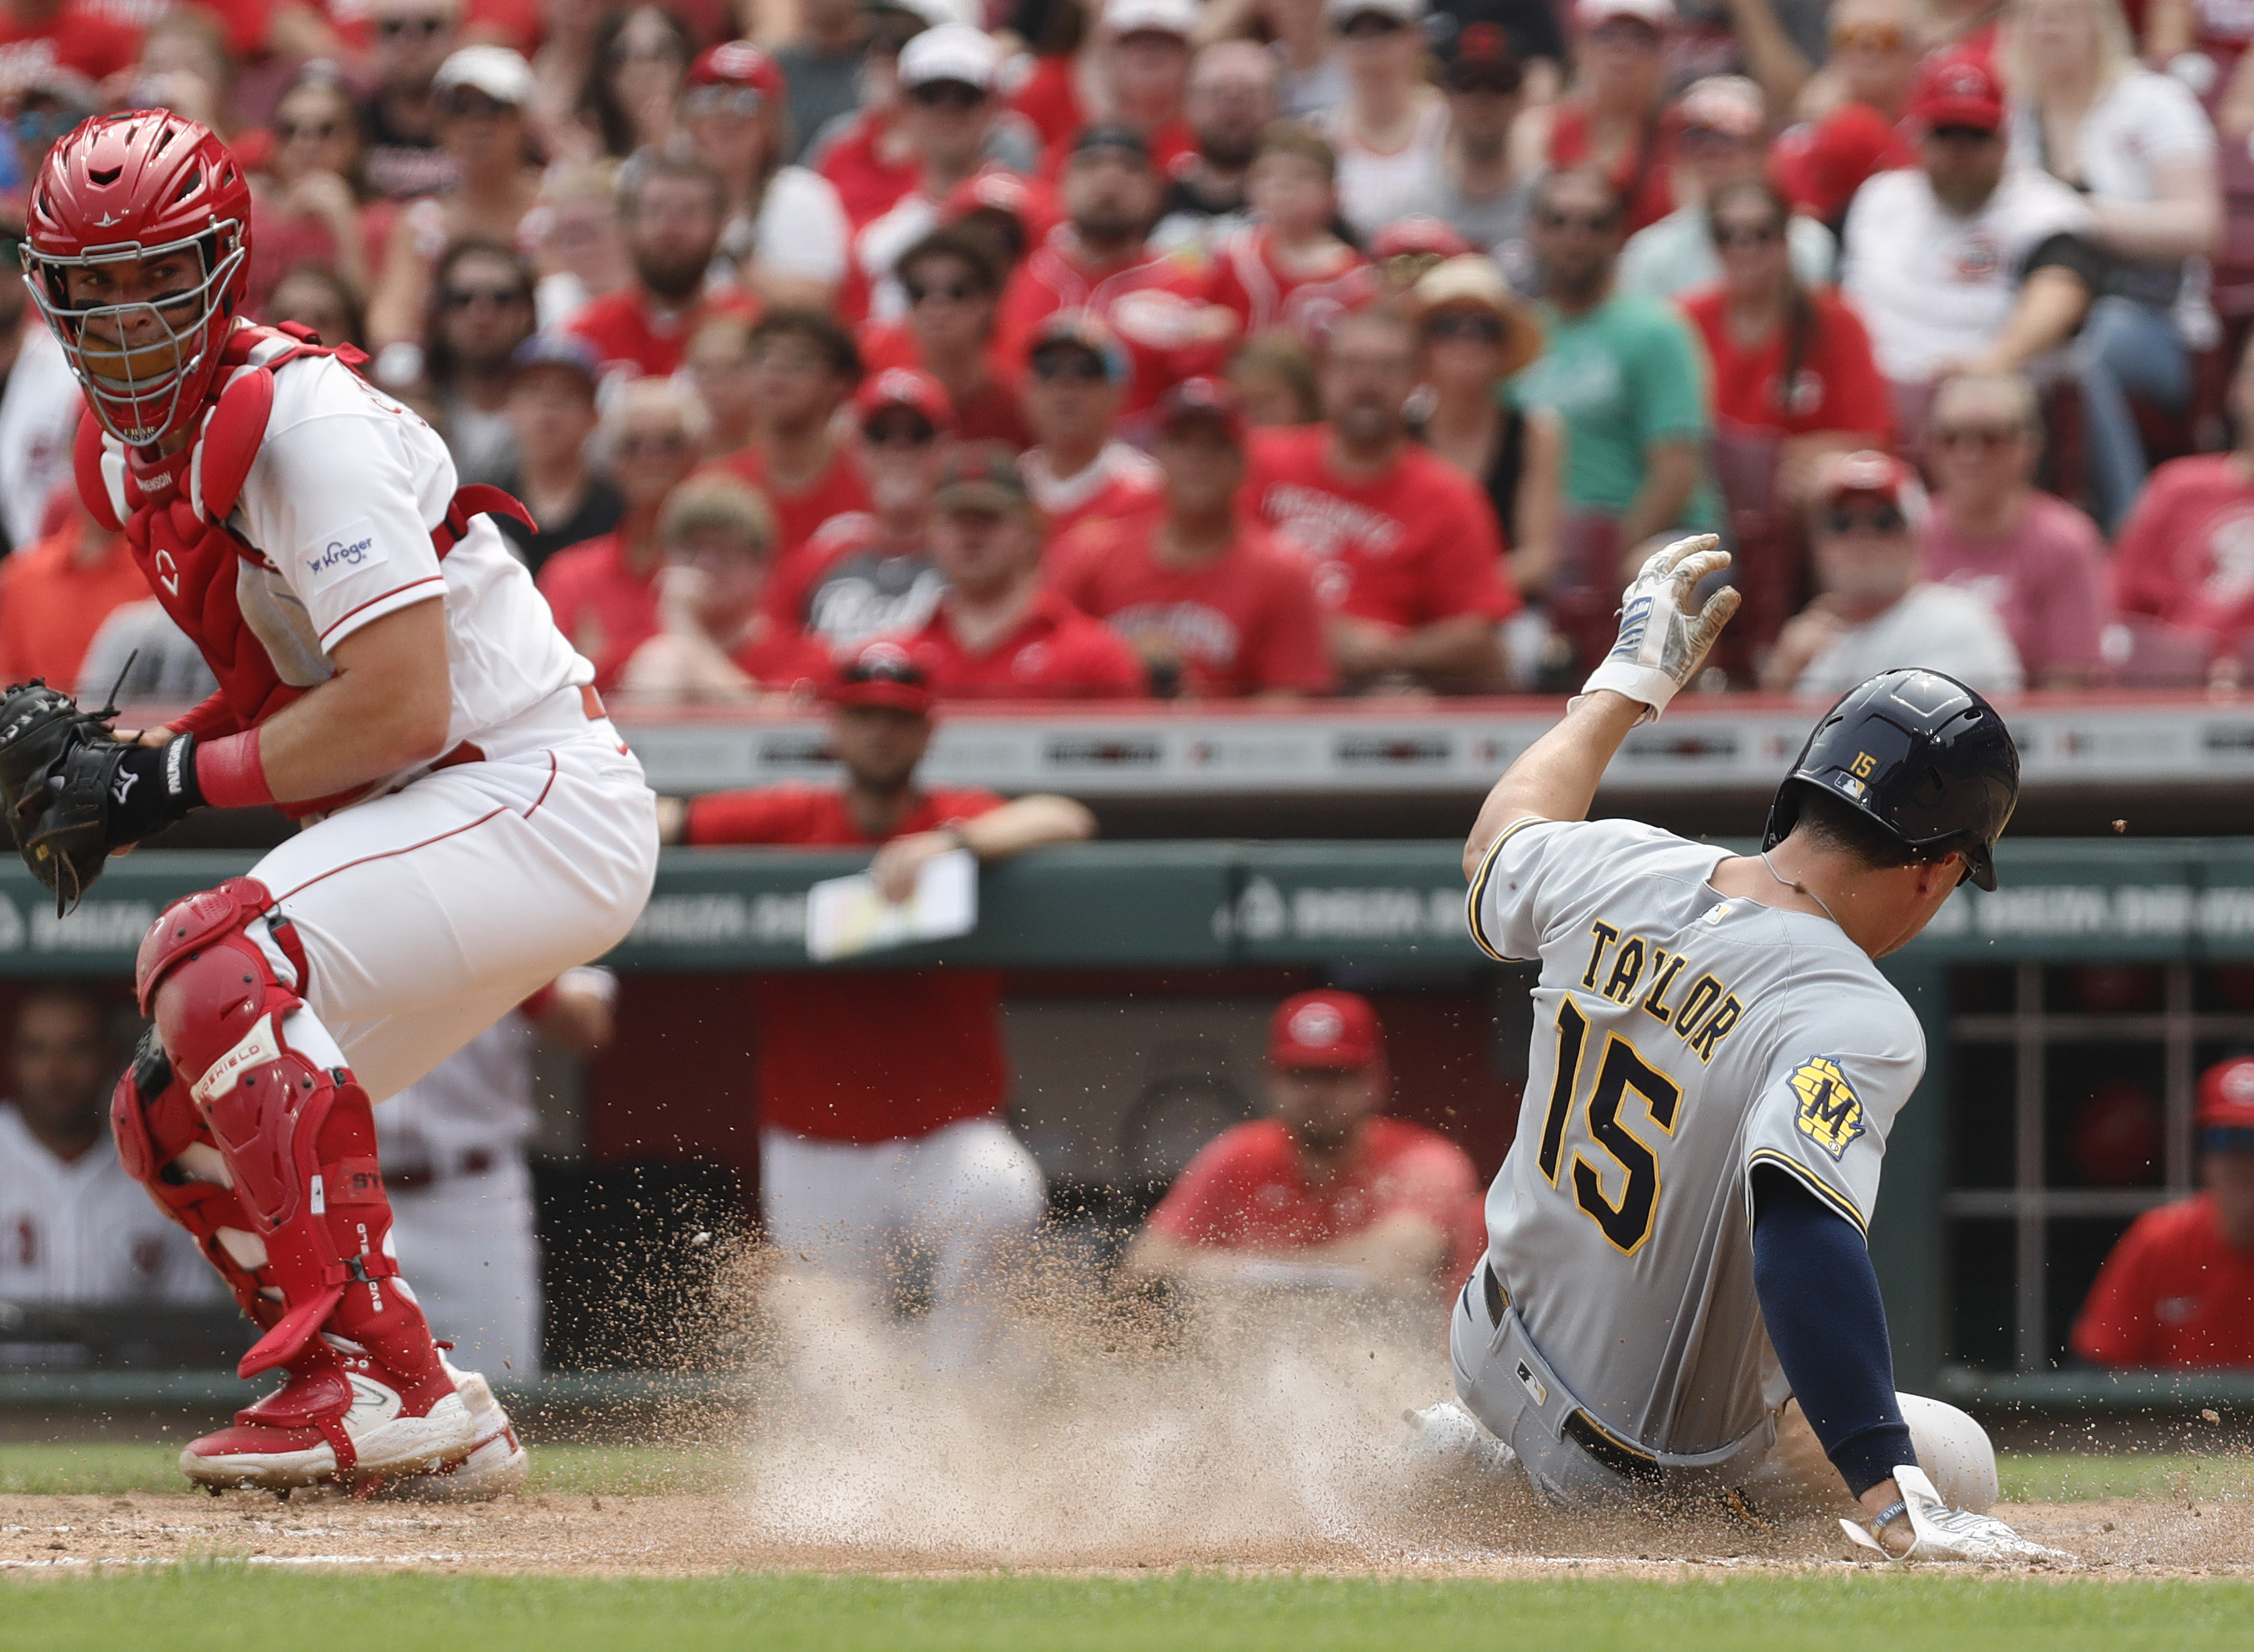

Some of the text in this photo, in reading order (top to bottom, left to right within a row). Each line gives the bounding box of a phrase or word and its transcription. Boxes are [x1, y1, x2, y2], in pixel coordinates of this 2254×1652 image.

[322, 538, 373, 567] Kroger
[1850, 751, 1878, 779] 15
[1581, 918, 1745, 1065] TAYLOR
[1536, 990, 1684, 1257] 15
[1804, 1077, 1856, 1139] M
